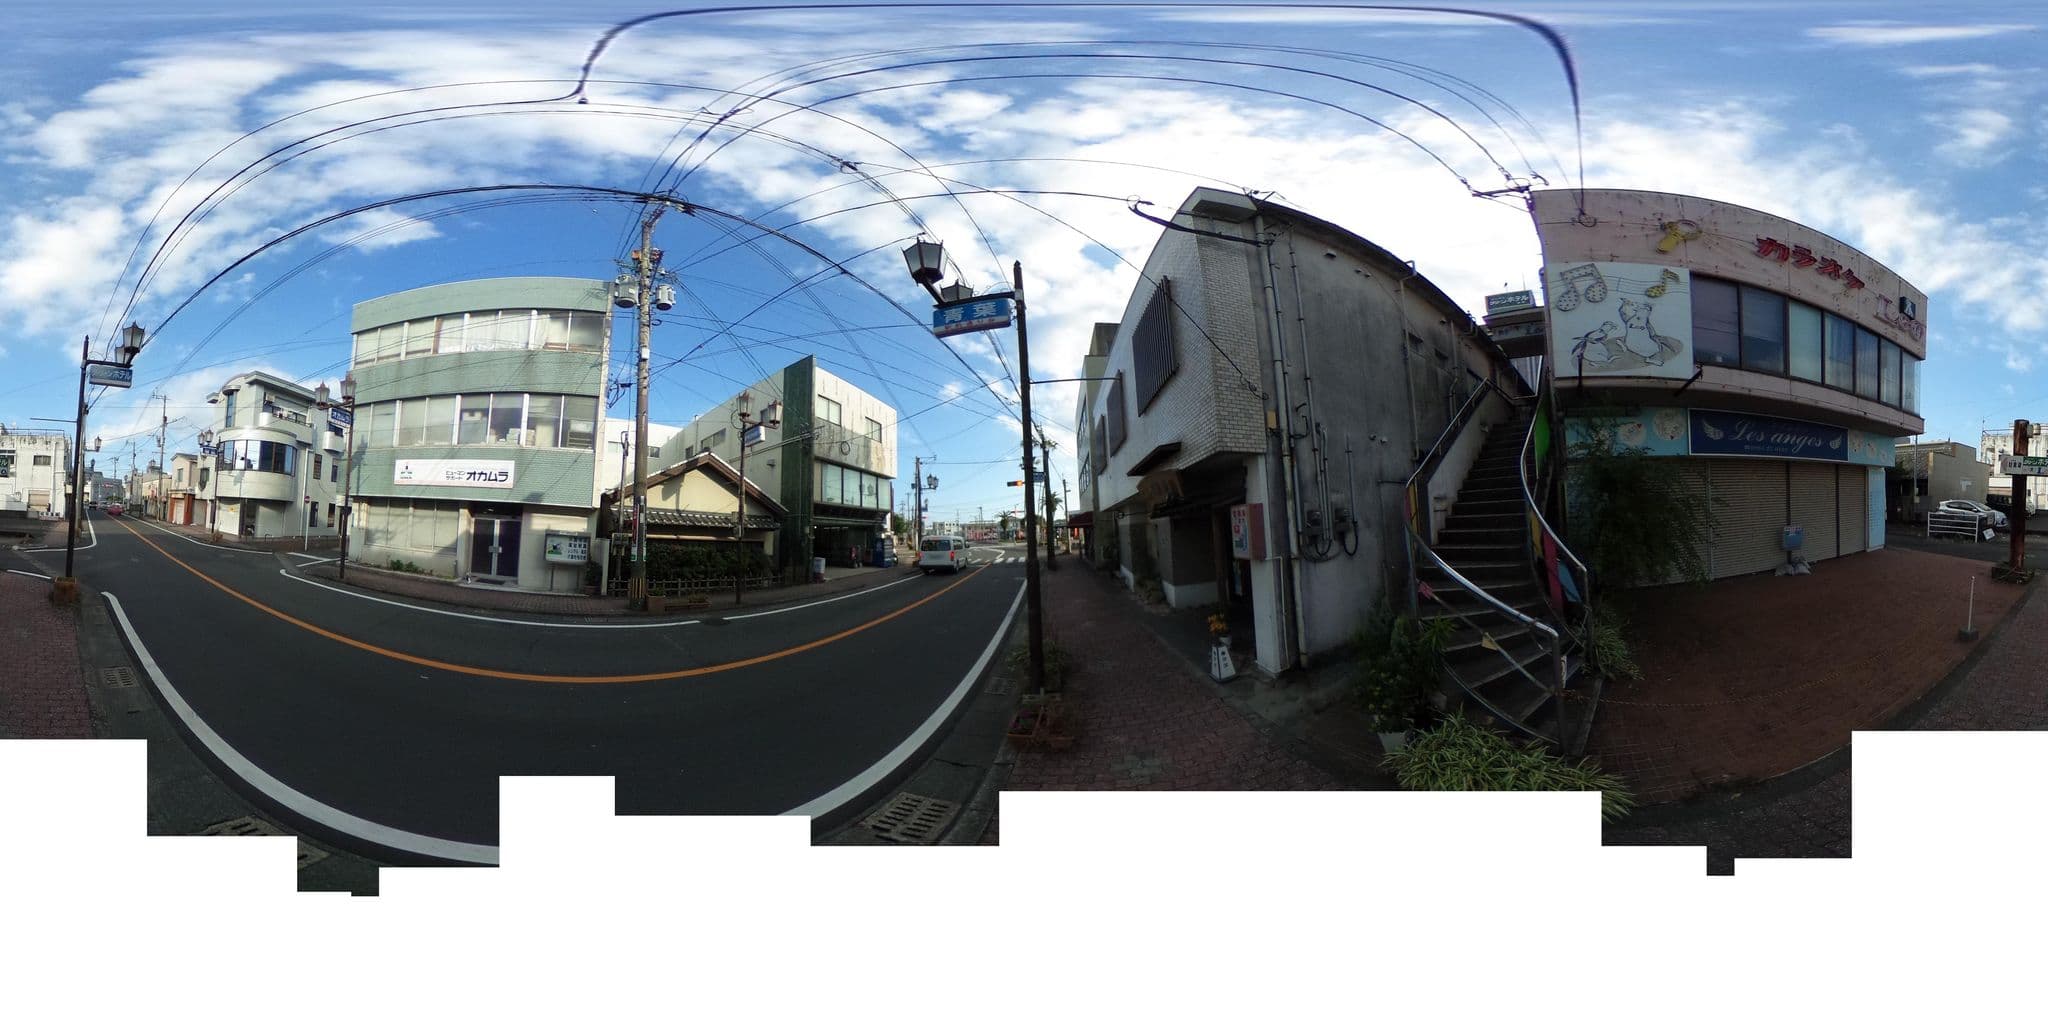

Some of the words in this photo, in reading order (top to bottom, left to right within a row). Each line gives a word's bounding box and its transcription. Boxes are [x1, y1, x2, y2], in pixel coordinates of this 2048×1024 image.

[1756, 237, 1865, 288] カラオケ
[1729, 421, 1765, 441] Les
[466, 471, 509, 482] オカムラ
